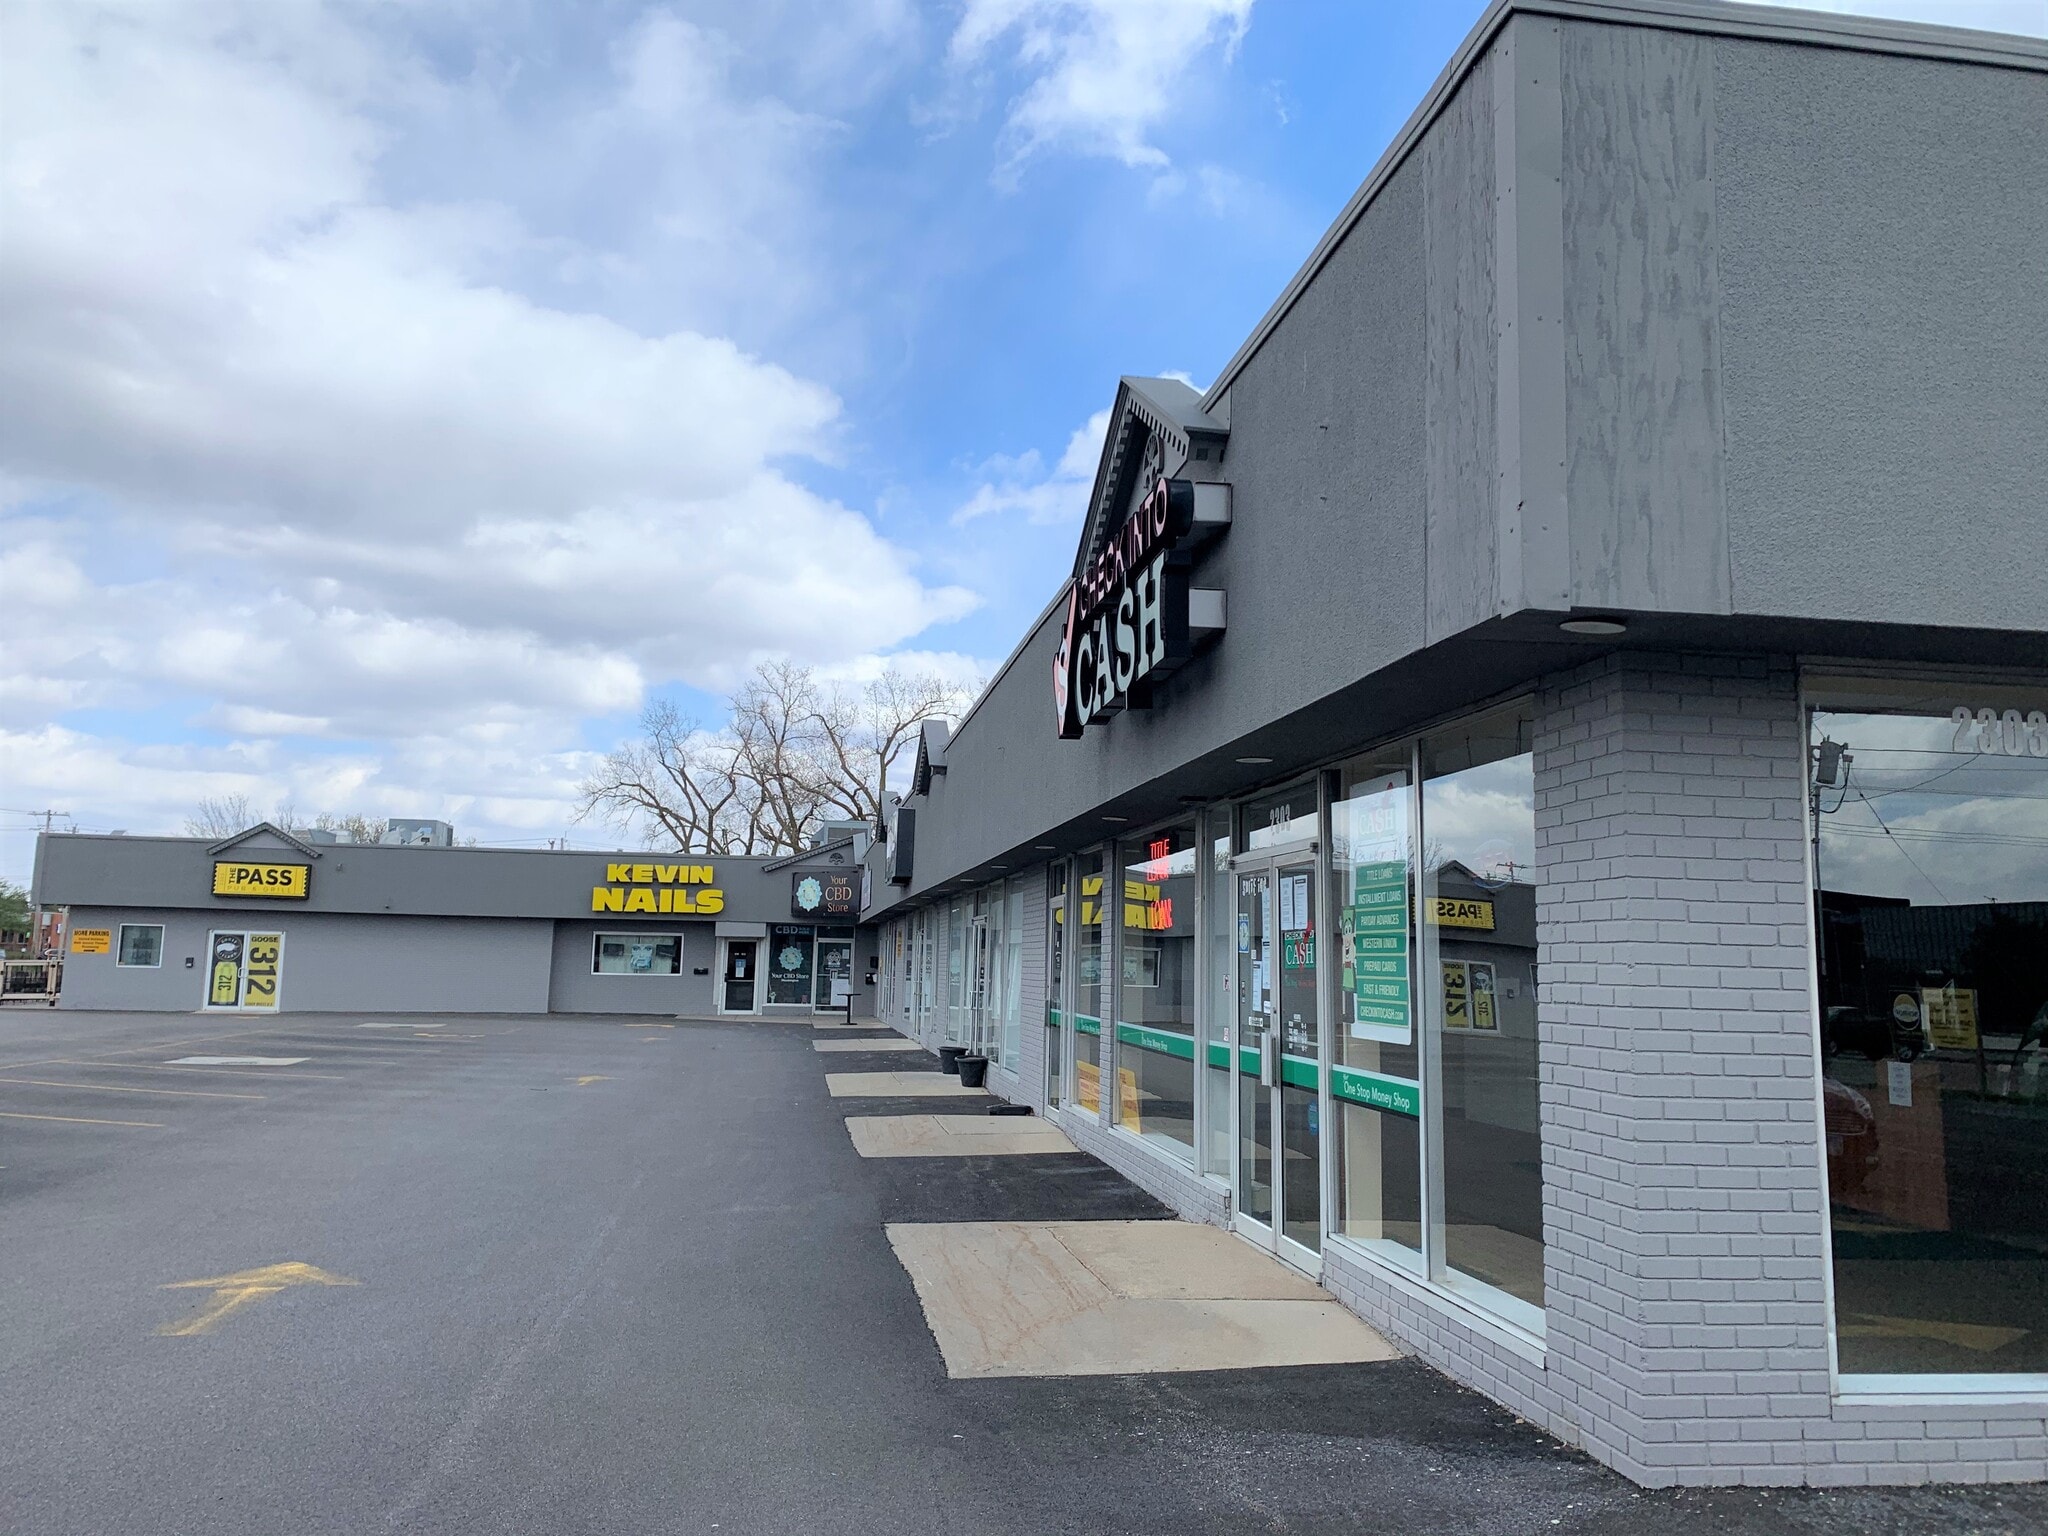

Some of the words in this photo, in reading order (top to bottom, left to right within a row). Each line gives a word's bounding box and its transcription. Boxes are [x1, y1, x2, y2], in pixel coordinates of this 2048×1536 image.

[1128, 477, 1168, 569] INTO
[1076, 550, 1165, 726] CASH
[1951, 706, 2048, 758] 2303
[236, 868, 292, 886] PASS
[607, 863, 714, 884] KEVIN
[831, 875, 848, 885] Your
[592, 887, 724, 914] NAILS
[825, 886, 852, 901] CBD
[827, 902, 849, 912] Store
[775, 925, 798, 934] CBD
[1286, 943, 1314, 965] CASH
[246, 946, 279, 996] 312
[217, 974, 233, 992] 312
[1363, 983, 1375, 994] FAST
[1379, 985, 1400, 996] FRIENDLY
[1343, 1080, 1356, 1095] One
[1356, 1083, 1371, 1102] Stop
[1371, 1087, 1392, 1108] Money
[1393, 1092, 1410, 1113] Shop
